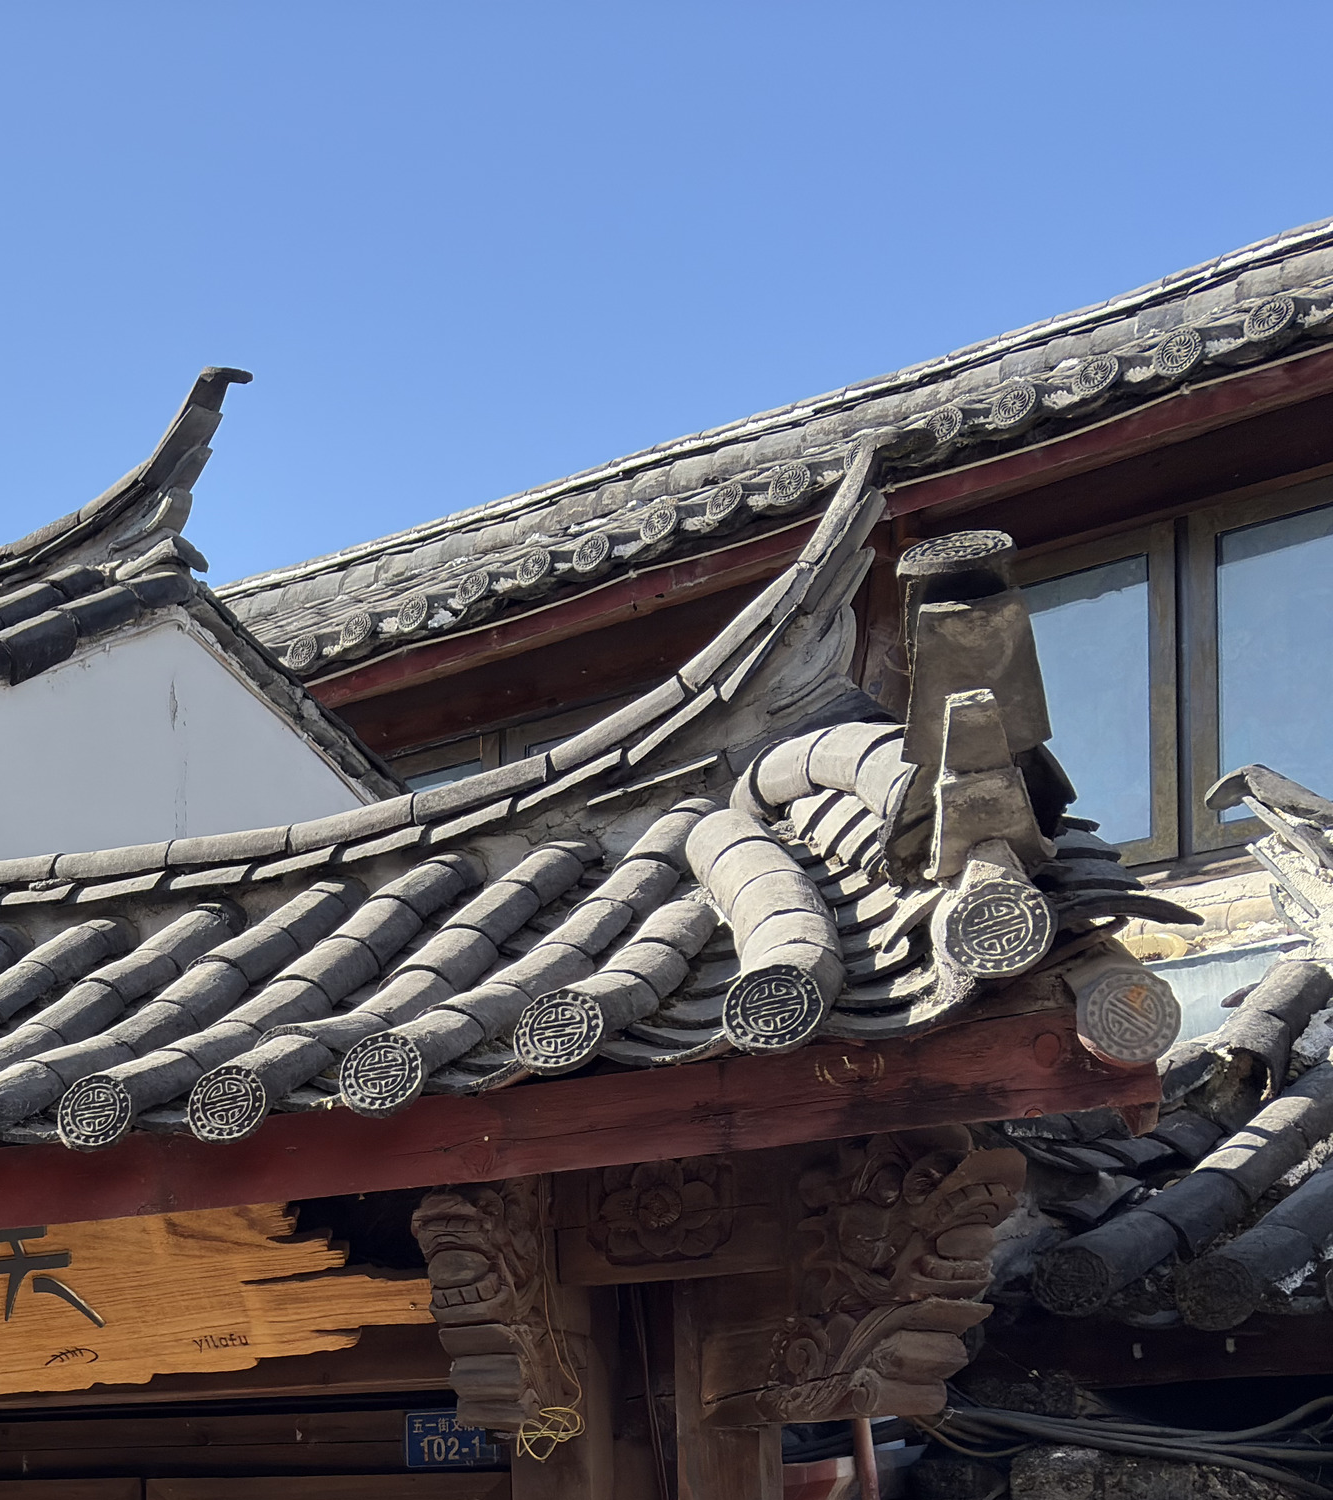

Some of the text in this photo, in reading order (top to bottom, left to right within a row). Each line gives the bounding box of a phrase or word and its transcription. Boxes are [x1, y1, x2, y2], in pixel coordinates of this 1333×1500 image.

[193, 1333, 250, 1353] yilafu
[412, 1417, 486, 1434] 五一街文
[419, 1435, 481, 1462] 102-1
